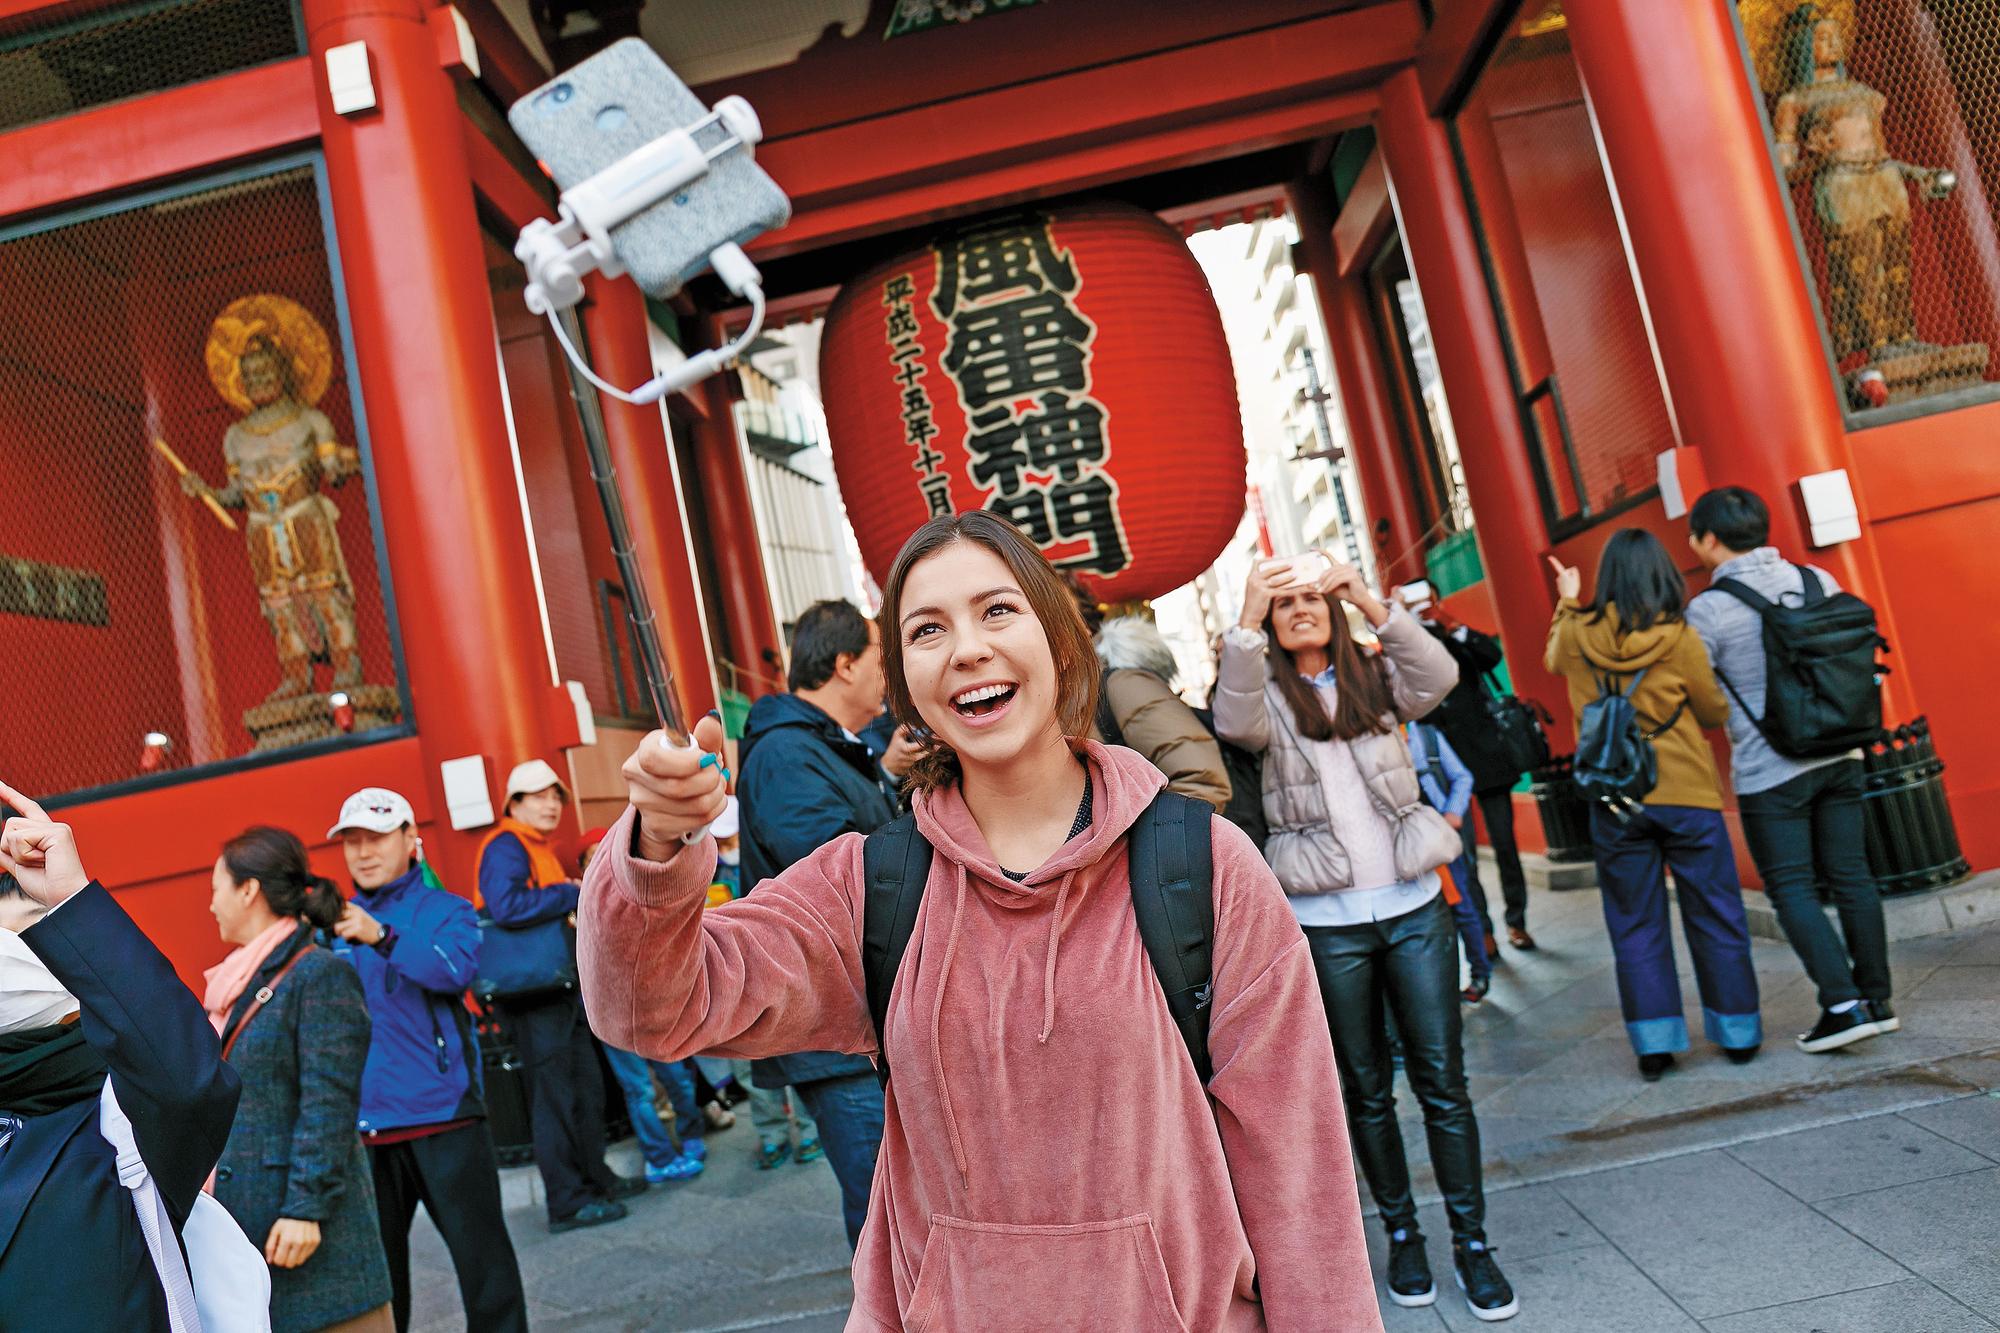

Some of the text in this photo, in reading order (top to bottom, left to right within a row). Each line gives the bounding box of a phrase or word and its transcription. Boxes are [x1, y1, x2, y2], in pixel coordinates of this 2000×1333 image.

[883, 273, 954, 517] 平成二十五年十一月
[929, 214, 1133, 577] 風雷神門
